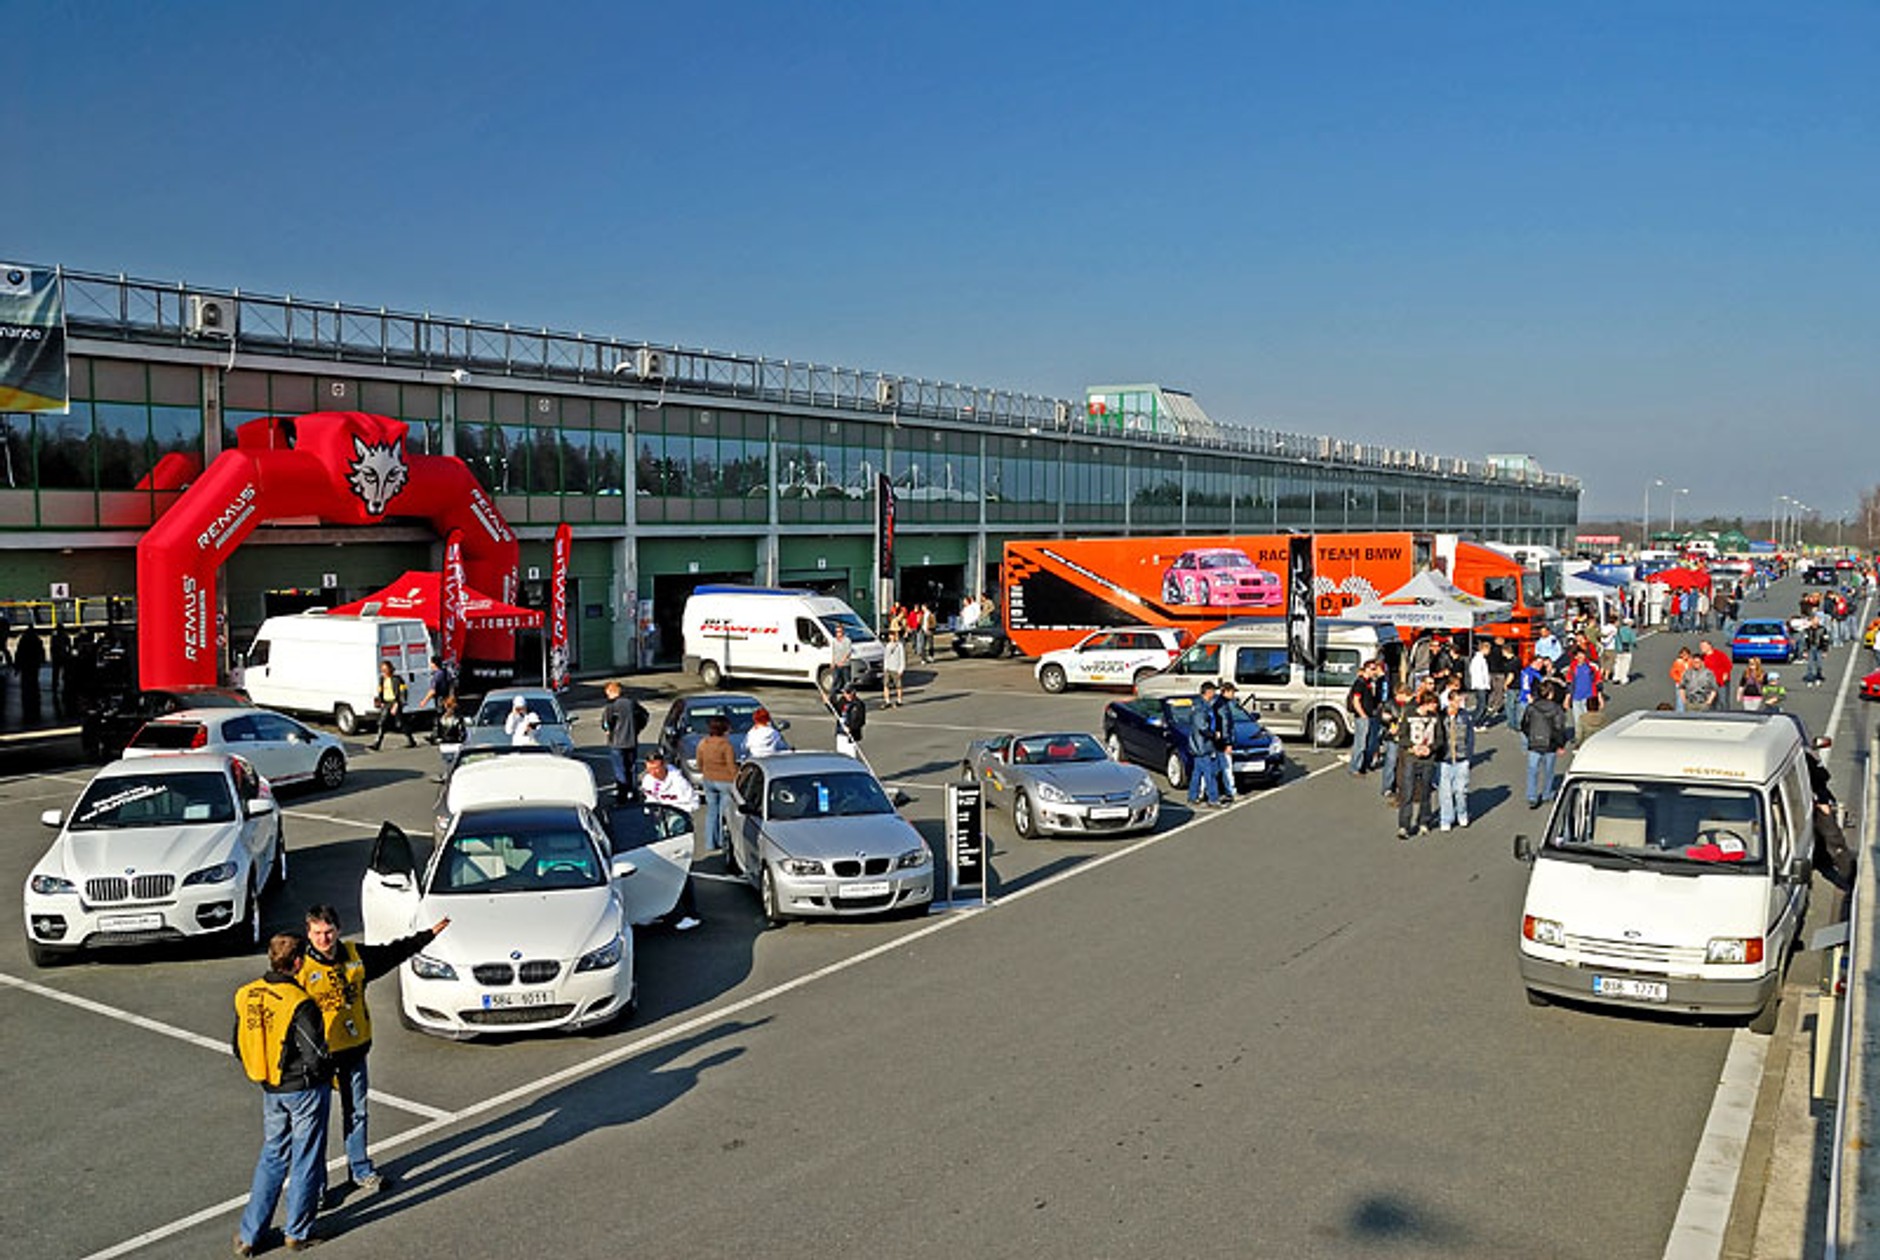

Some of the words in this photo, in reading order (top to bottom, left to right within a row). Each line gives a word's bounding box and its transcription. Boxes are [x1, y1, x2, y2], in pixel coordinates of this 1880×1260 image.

[197, 487, 256, 550] REMUS
[1319, 548, 1360, 561] TEAM
[1365, 548, 1402, 561] BMW
[183, 577, 198, 661] REMUS
